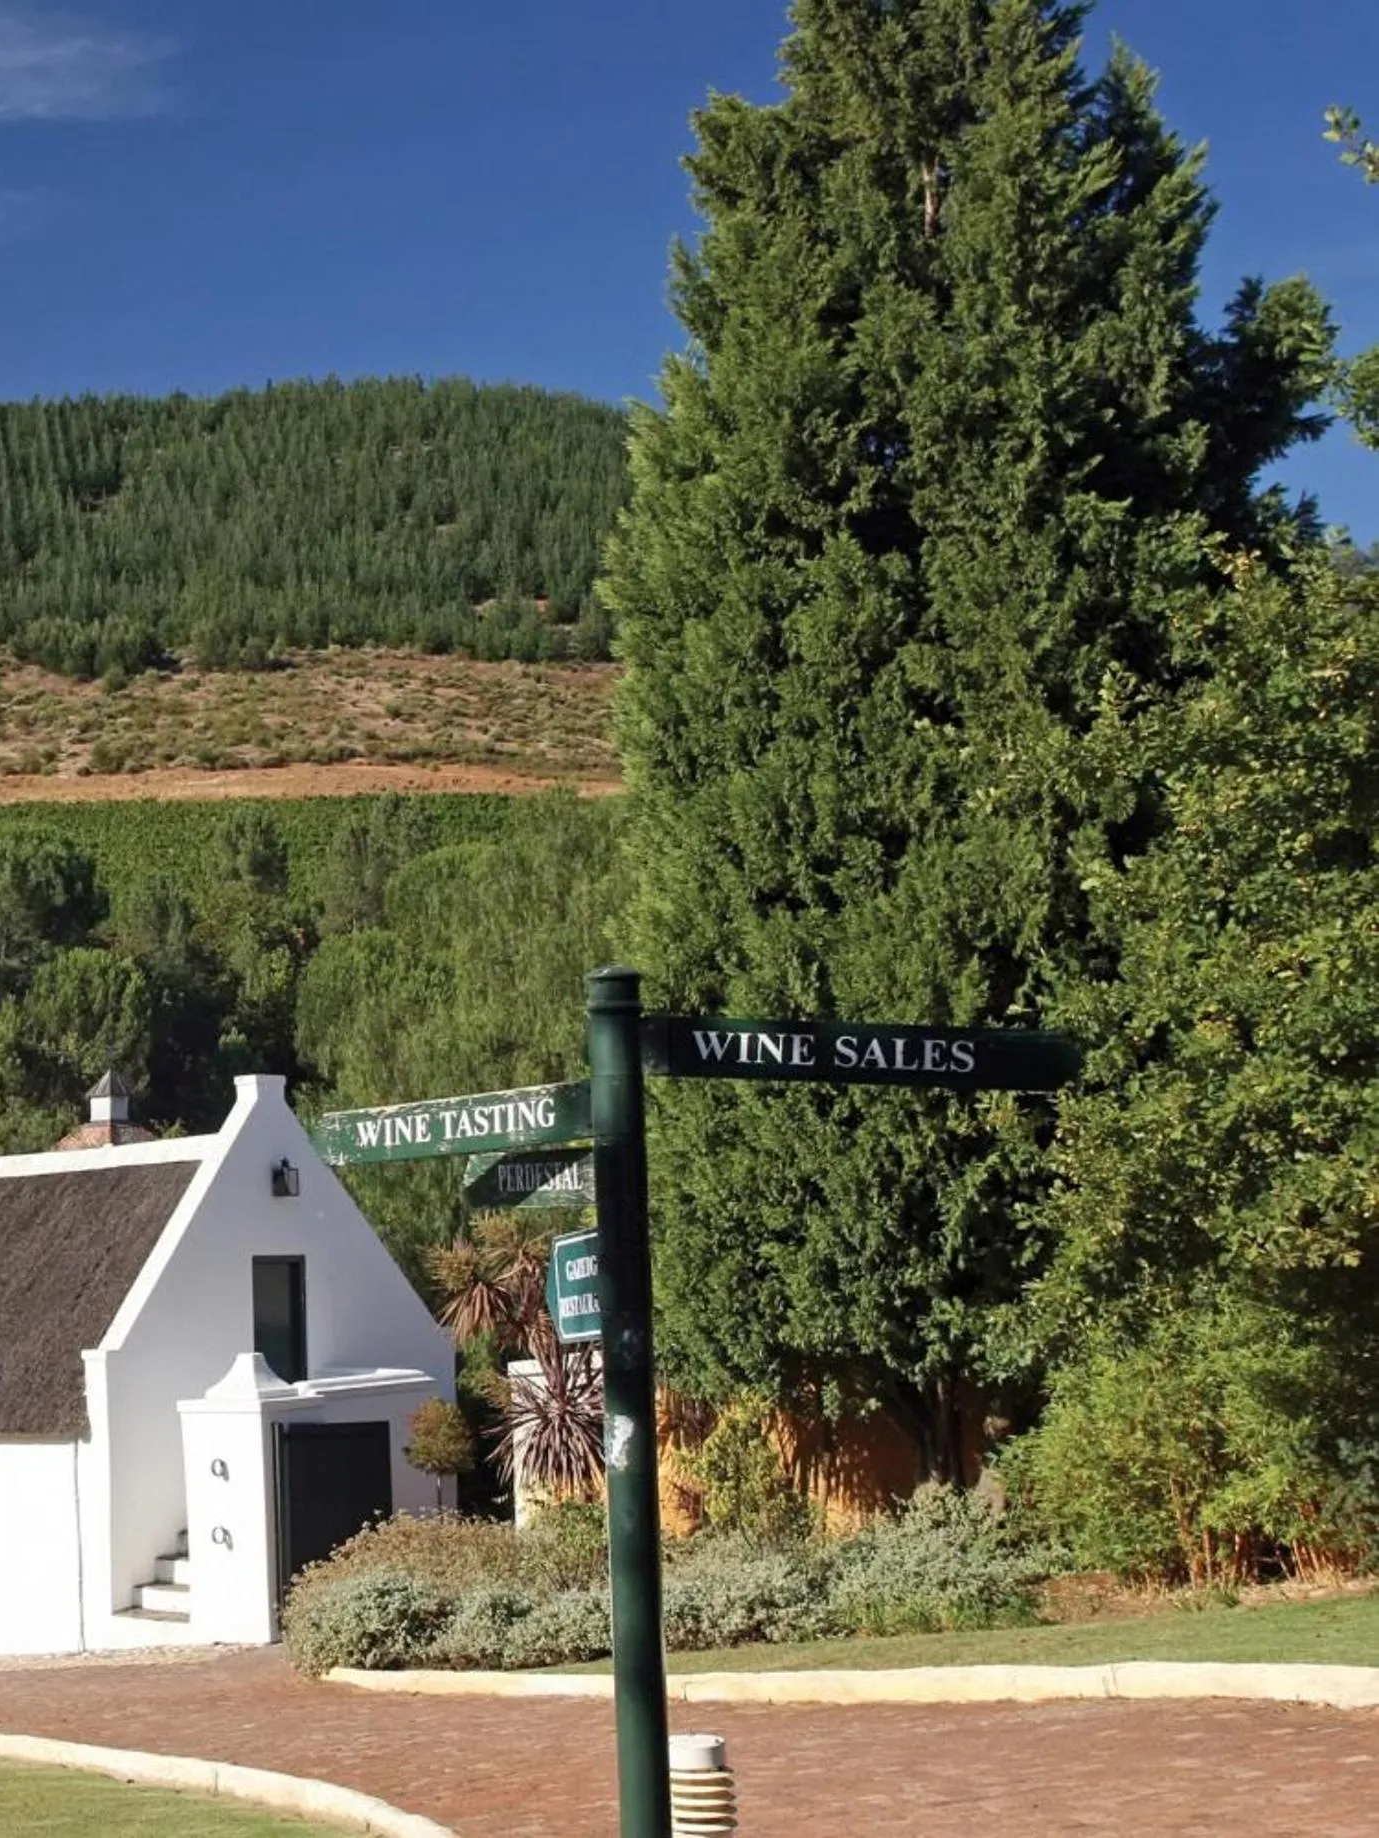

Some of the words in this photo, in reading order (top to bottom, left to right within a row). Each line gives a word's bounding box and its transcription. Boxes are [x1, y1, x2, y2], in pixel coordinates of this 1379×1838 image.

[692, 1030, 816, 1066] WINE
[834, 1035, 975, 1073] SALES
[356, 1113, 432, 1148] WINE
[439, 1098, 556, 1140] TASTING
[497, 1161, 583, 1192] PERDESTAL
